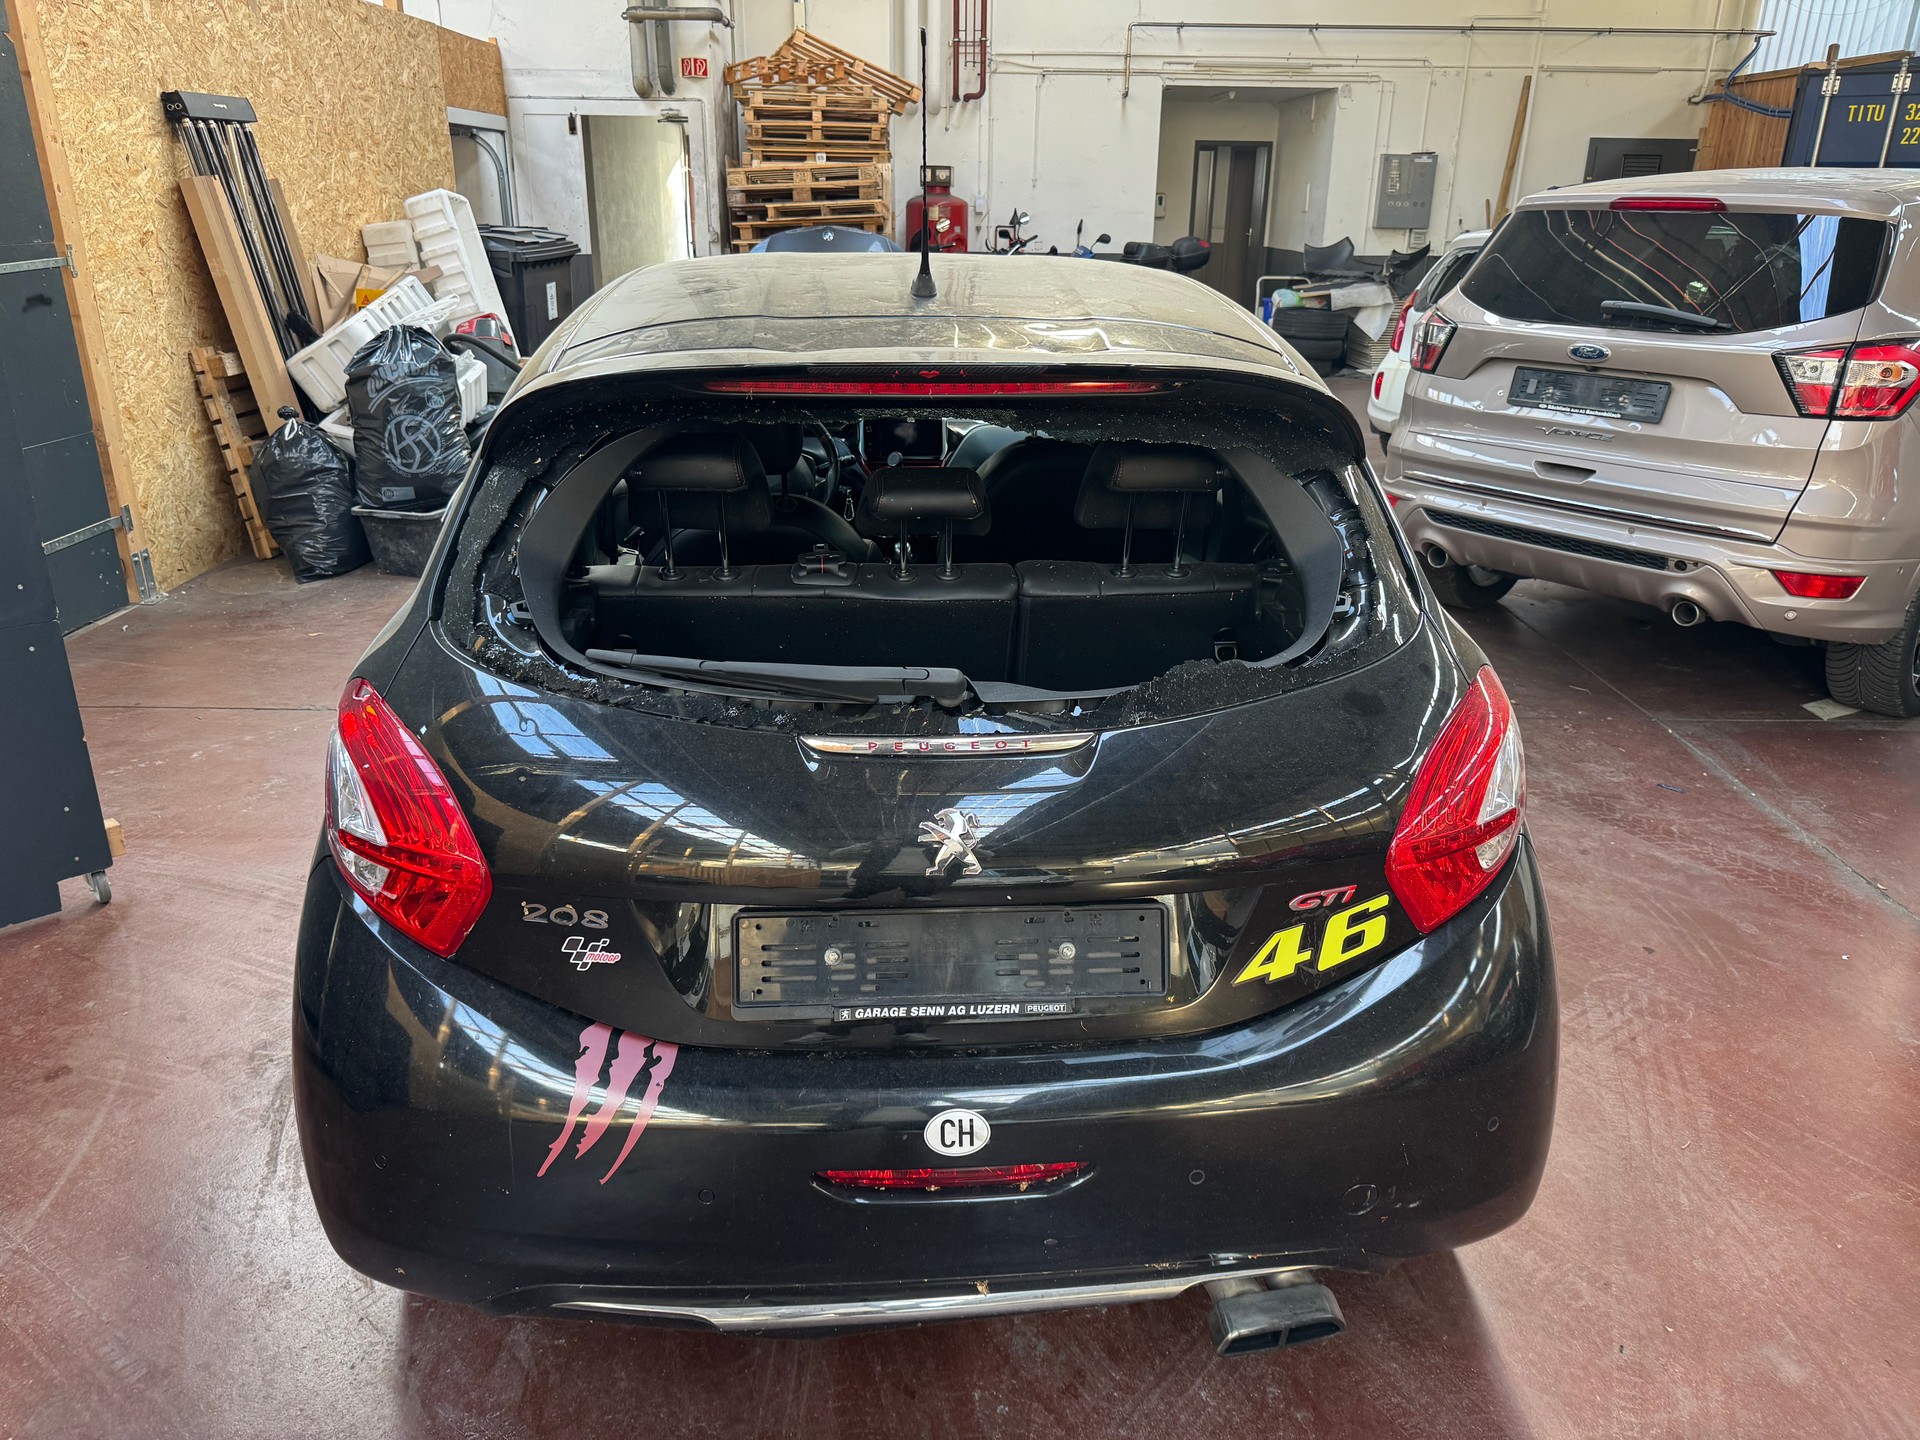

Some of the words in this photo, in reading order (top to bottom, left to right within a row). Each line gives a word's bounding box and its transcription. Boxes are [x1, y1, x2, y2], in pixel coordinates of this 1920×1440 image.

[1848, 104, 1886, 122] TITU
[1576, 346, 1600, 359] Ford
[867, 739, 1032, 752] PEUGEOT
[521, 903, 609, 929] 208
[1233, 893, 1390, 985] 46
[854, 1007, 907, 1019] GARAGE
[910, 1006, 945, 1017] SENN
[948, 1005, 966, 1016] AG
[969, 1004, 1020, 1015] LUZERN
[1026, 1004, 1066, 1012] PEUGEOT
[940, 1118, 975, 1148] CH
